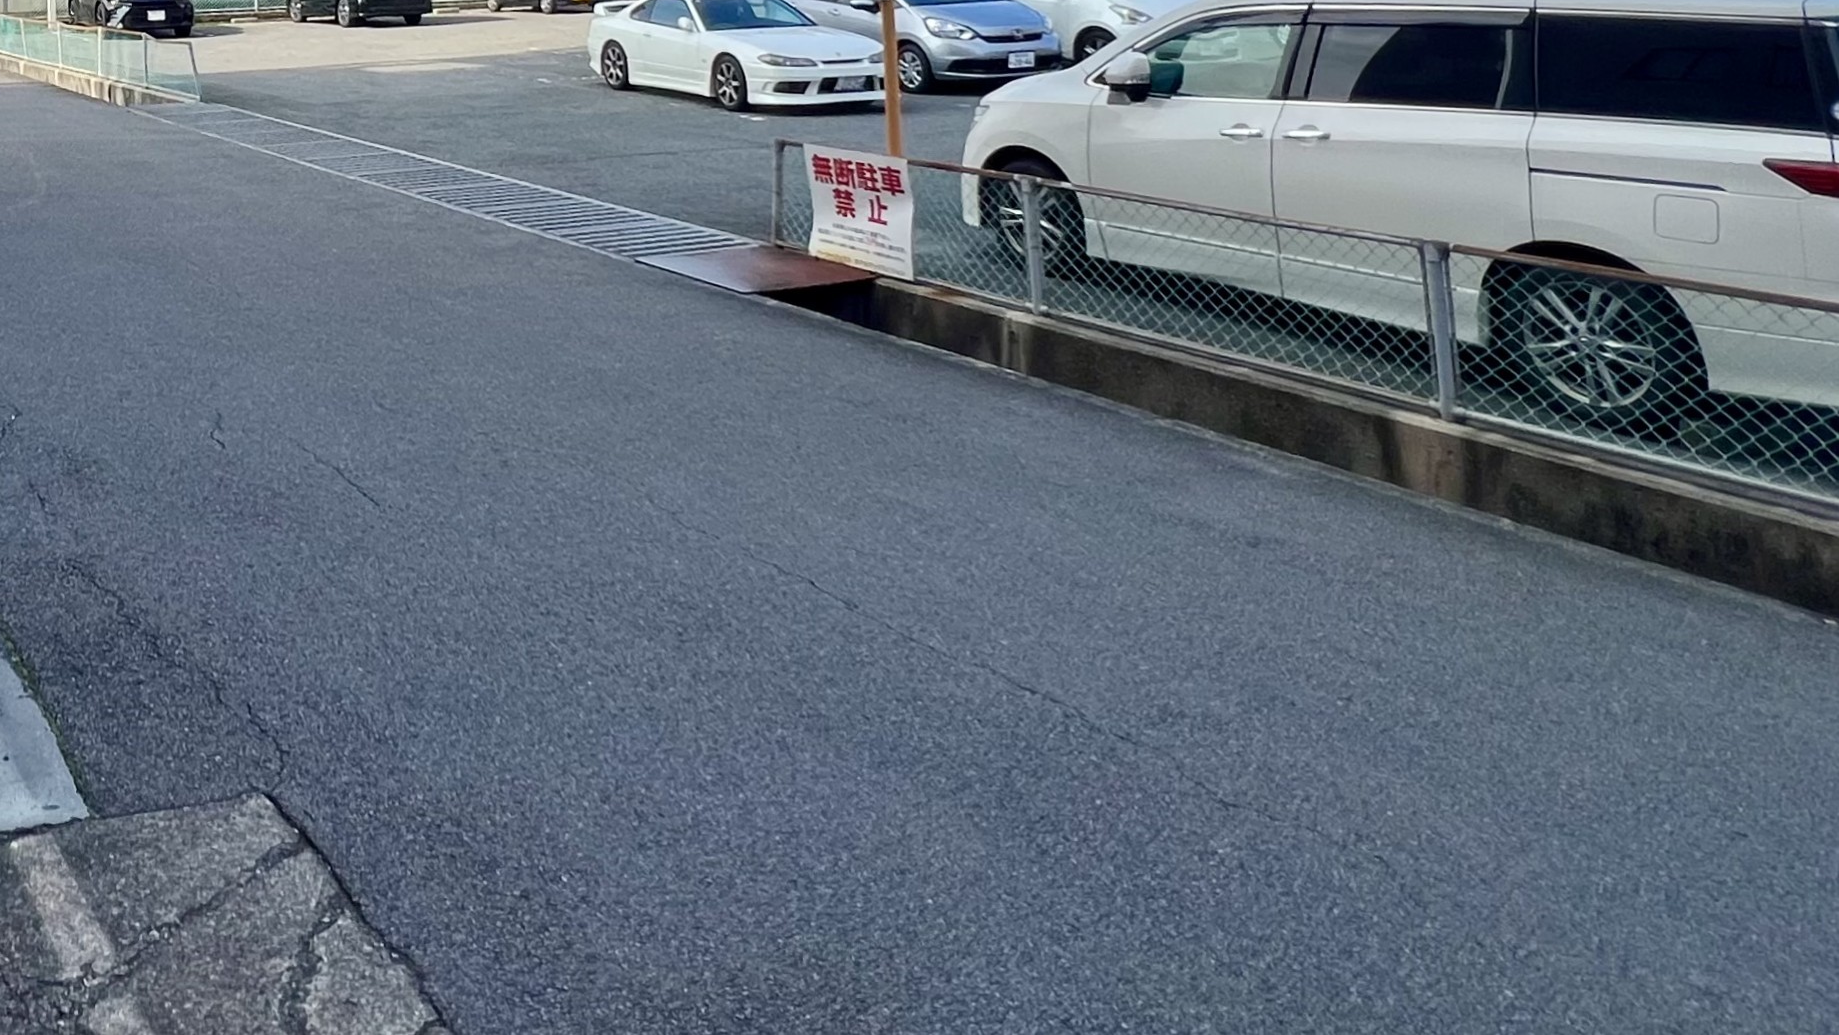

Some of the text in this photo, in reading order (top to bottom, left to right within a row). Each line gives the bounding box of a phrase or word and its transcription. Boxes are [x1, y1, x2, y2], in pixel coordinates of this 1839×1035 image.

[811, 154, 905, 196] 無断駐車
[832, 188, 888, 226] 禁止
